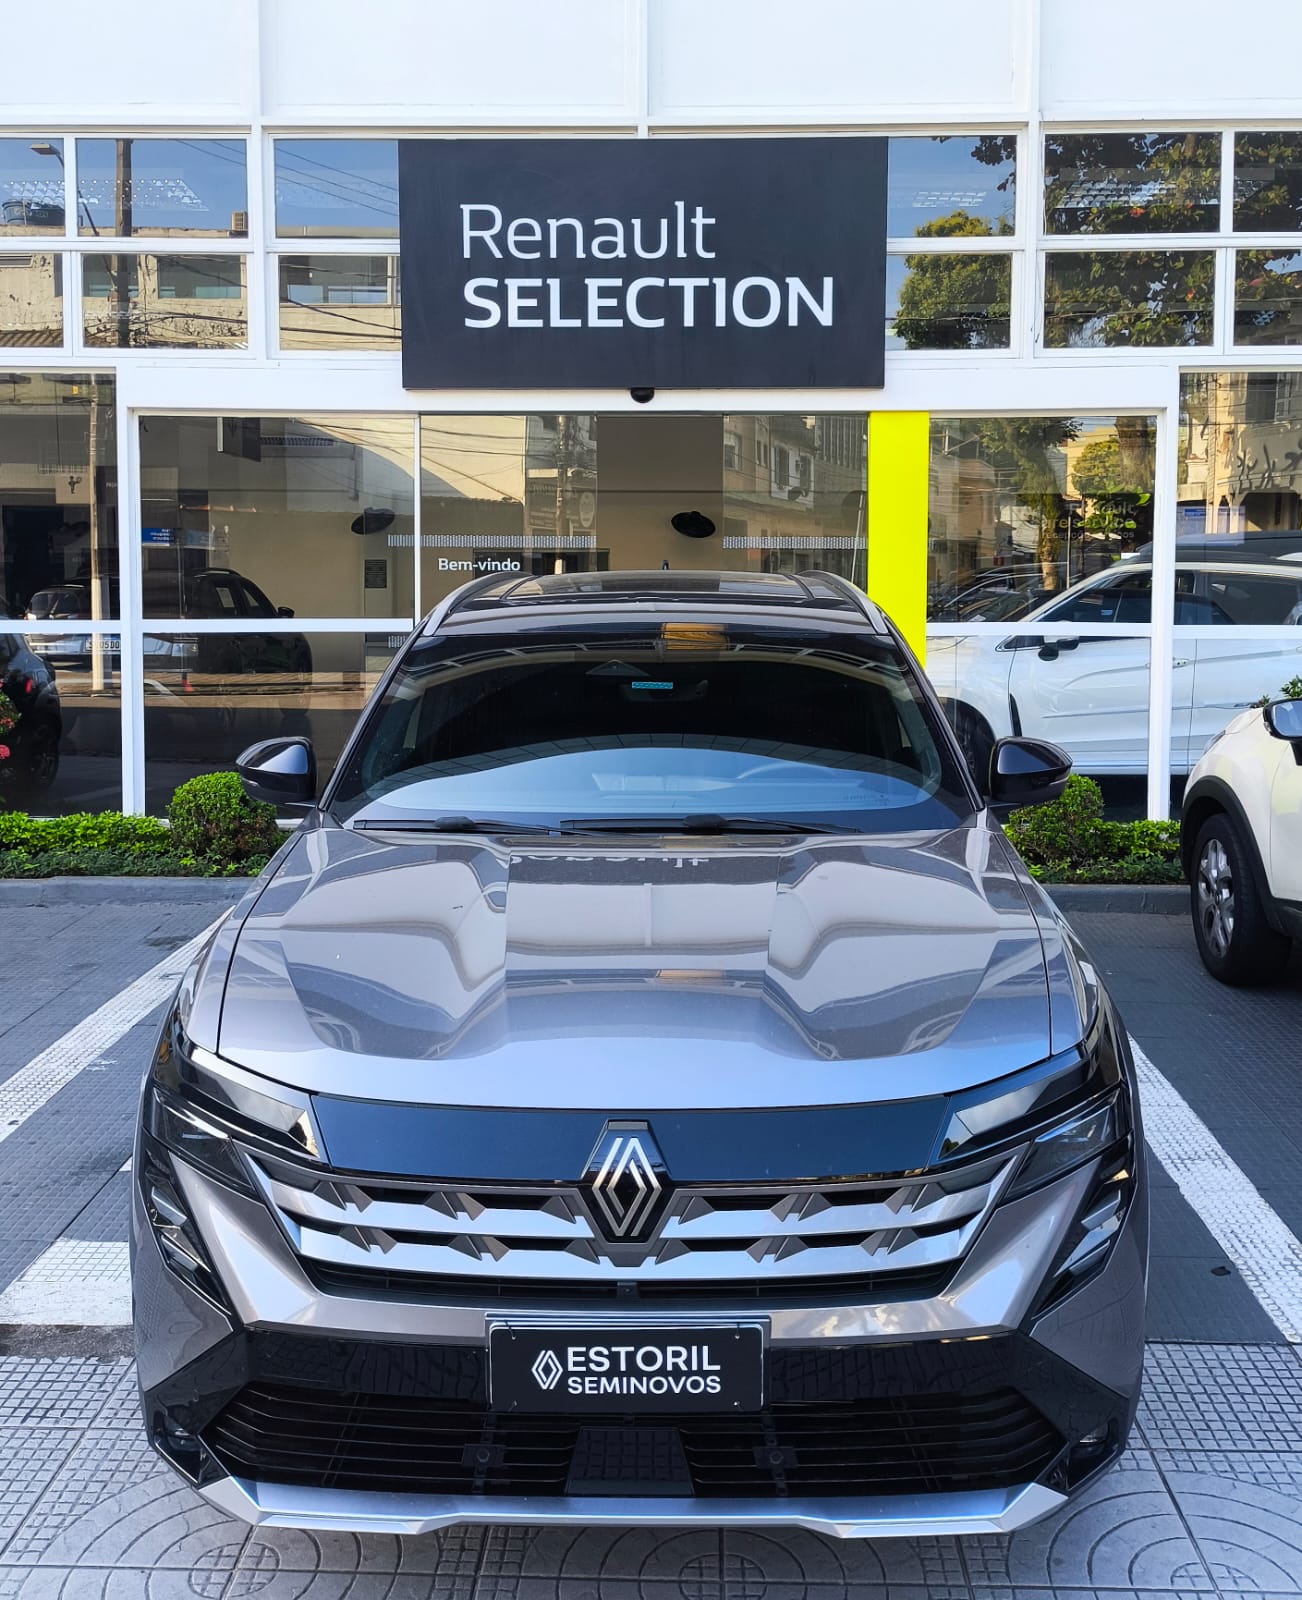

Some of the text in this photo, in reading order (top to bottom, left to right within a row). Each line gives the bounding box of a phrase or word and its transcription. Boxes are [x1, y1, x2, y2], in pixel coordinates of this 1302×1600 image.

[459, 200, 716, 260] Renault
[463, 276, 834, 328] SELECTION
[438, 557, 521, 571] Bem-vindo
[567, 1346, 721, 1372] ESTORIL
[567, 1375, 721, 1395] SEMINOVOS
